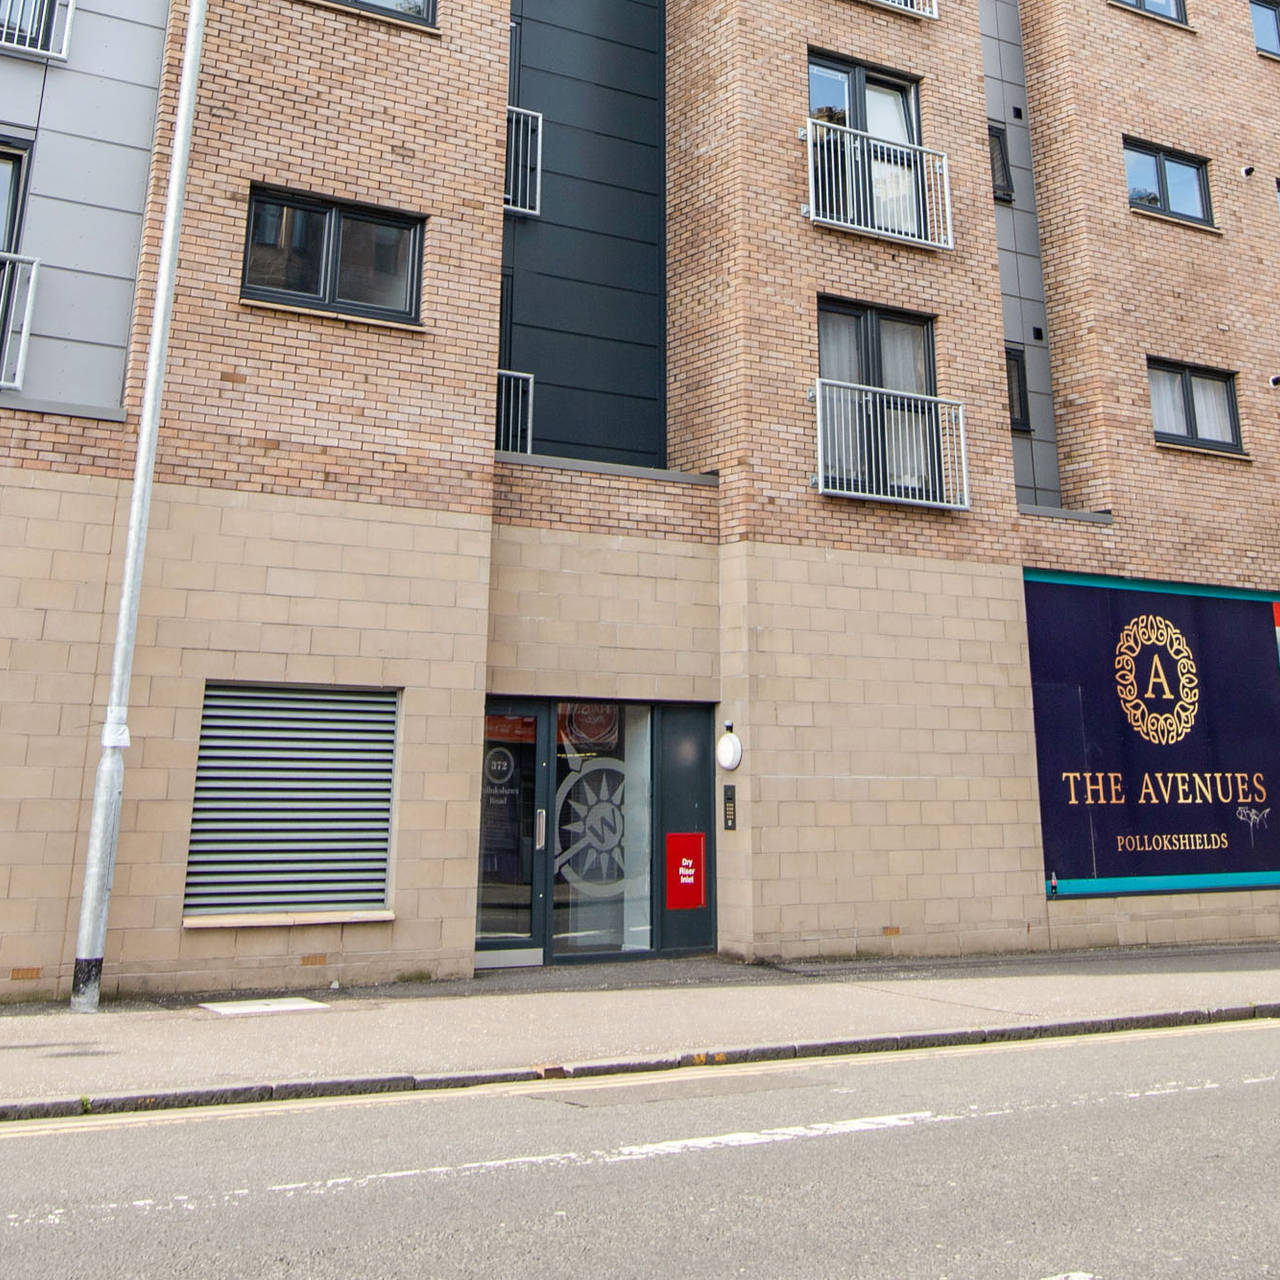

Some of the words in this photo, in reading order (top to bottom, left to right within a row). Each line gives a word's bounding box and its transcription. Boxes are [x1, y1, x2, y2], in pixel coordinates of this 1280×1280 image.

[1144, 653, 1174, 700] A
[491, 761, 508, 771] 372
[1062, 772, 1125, 805] THE
[1138, 771, 1267, 805] AVENUES
[1117, 832, 1228, 852] POLLOKSHIELDS
[681, 858, 693, 868] Dry
[679, 867, 696, 875] Riser
